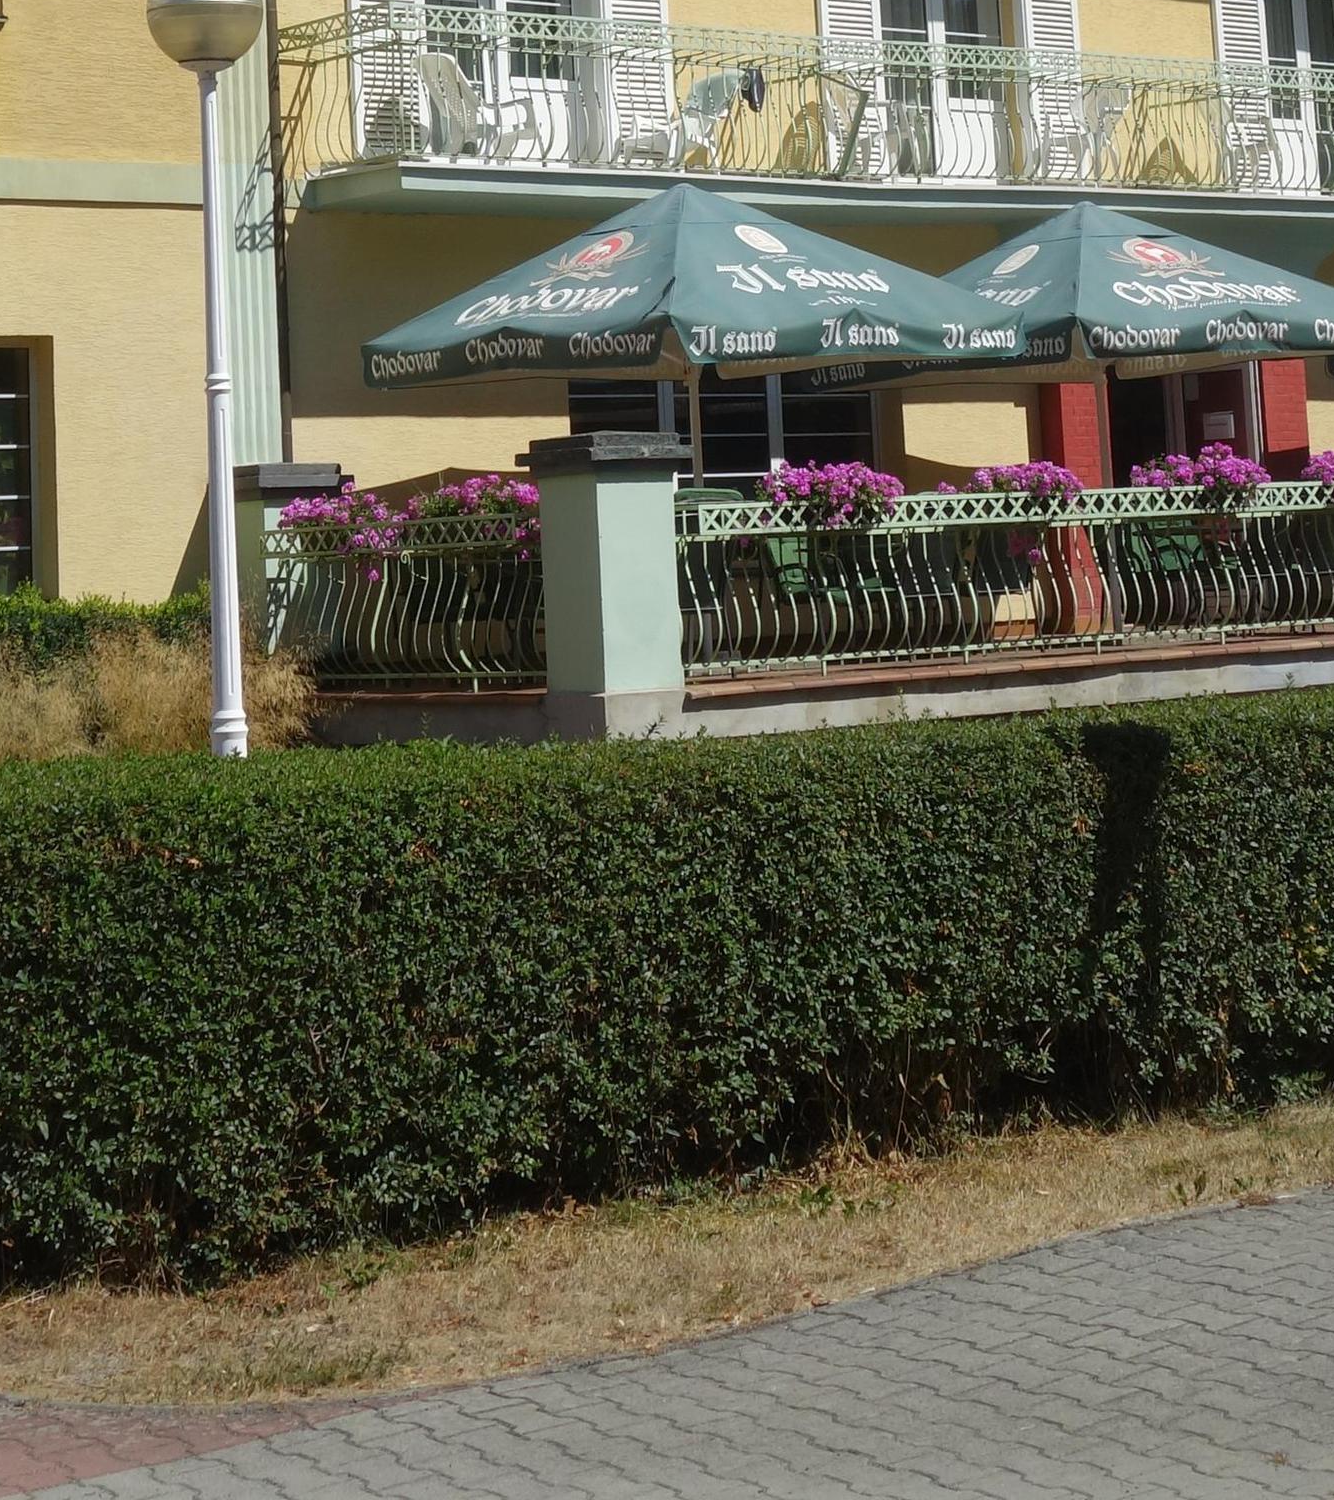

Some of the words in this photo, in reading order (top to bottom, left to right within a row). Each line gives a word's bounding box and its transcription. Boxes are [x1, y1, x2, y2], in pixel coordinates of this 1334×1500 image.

[976, 285, 1041, 306] ano
[1112, 276, 1302, 308] Chodovar
[453, 284, 639, 327] Chodovar
[722, 329, 777, 355] sano
[847, 324, 900, 347] sano
[970, 326, 1017, 349] sano
[1088, 325, 1180, 350] Chodovar
[1206, 317, 1289, 343] Chodovar
[465, 332, 545, 365] Chodovar
[568, 330, 656, 358] Chodovar
[371, 350, 441, 380] Chodovar
